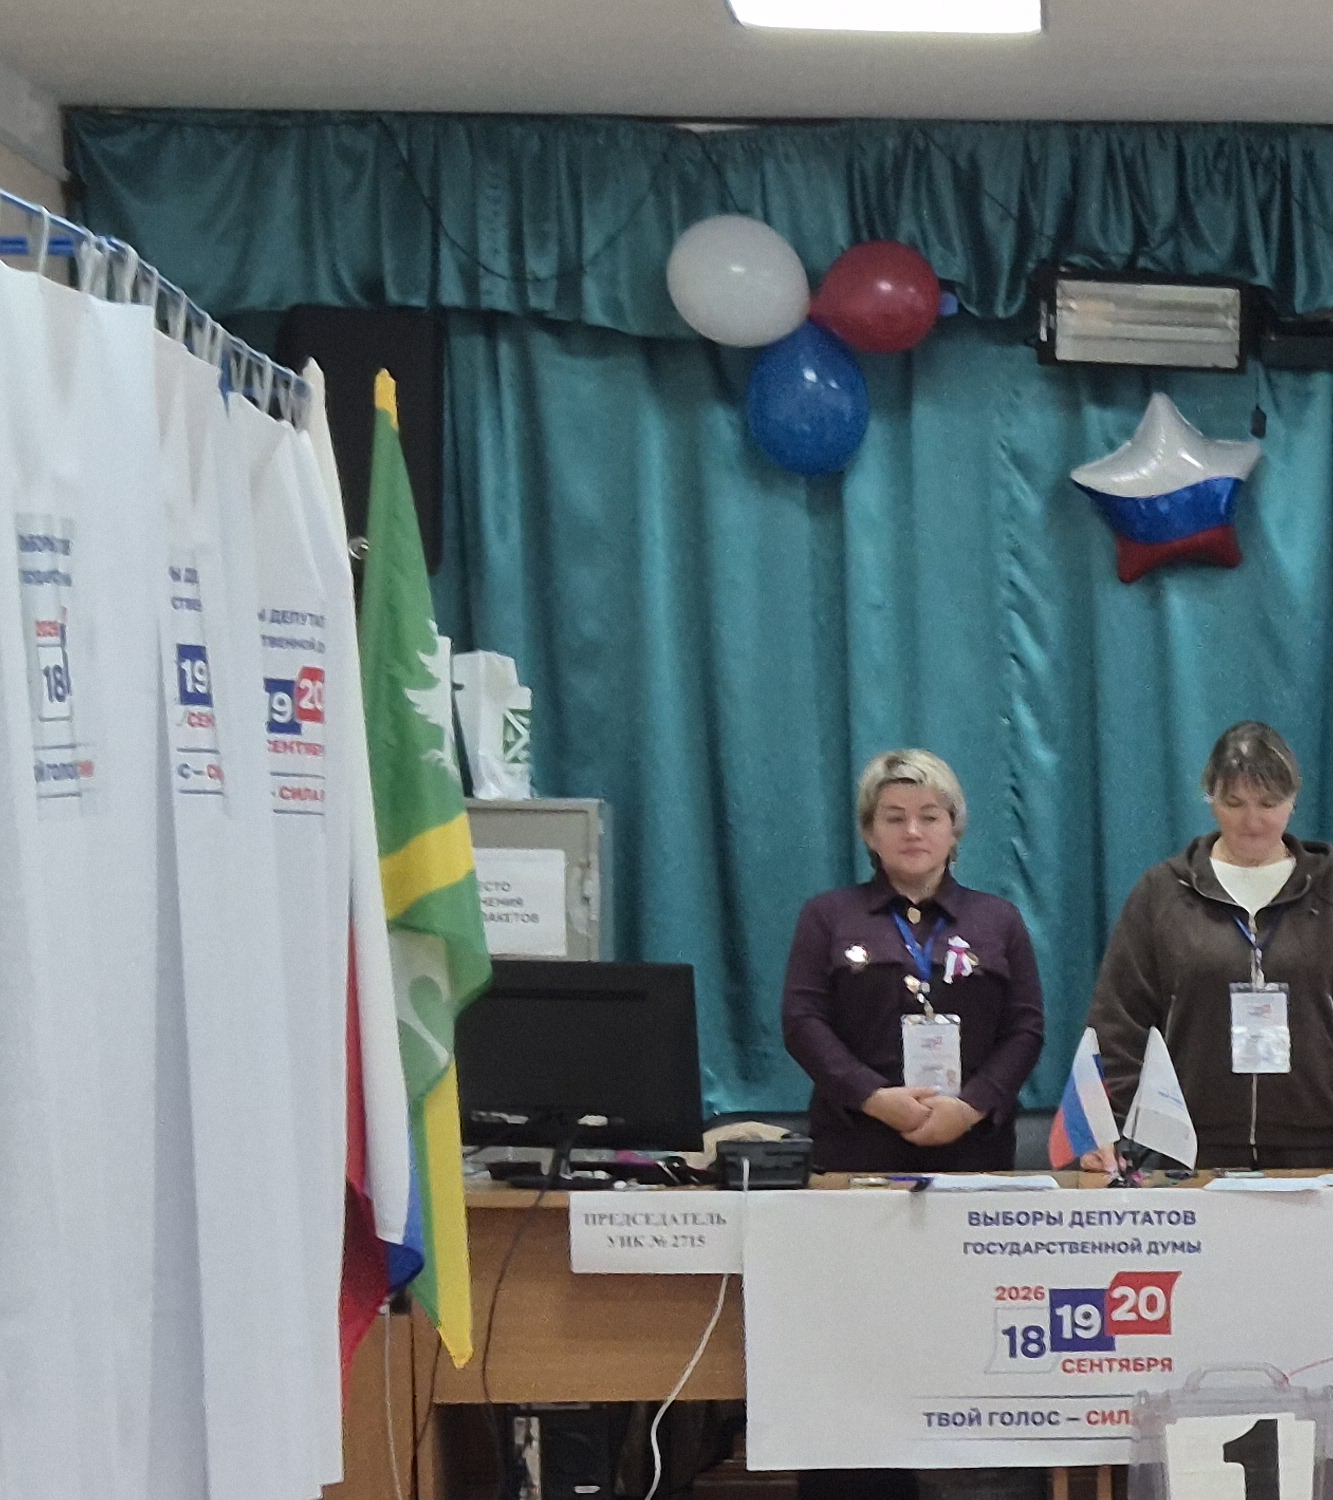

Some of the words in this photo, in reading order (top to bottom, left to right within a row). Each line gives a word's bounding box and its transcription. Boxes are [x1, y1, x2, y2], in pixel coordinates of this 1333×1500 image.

[43, 664, 66, 703] 18
[181, 659, 209, 693] 19
[271, 691, 294, 723] 9
[584, 1212, 727, 1226] ПРЕДСЕДАТЕЛЬ
[967, 1209, 1064, 1227] ВЫБОРЫ
[1069, 1209, 1197, 1229] ДЕПУТАТОВ
[671, 1234, 706, 1249] 2715
[963, 1238, 1142, 1256] ГОСУДАРСТВЕННОЙ
[1146, 1239, 1202, 1256] ДУМЫ
[994, 1285, 1046, 1302] 2026
[1002, 1325, 1047, 1359] 18
[1055, 1303, 1102, 1340] 19
[1110, 1285, 1167, 1322] 20
[1061, 1357, 1173, 1375] СЕНТЯБРЯ
[923, 1407, 982, 1427] ТВОЙ
[987, 1409, 1061, 1427] ГОЛОС
[1086, 1408, 1133, 1426] СИЛ
